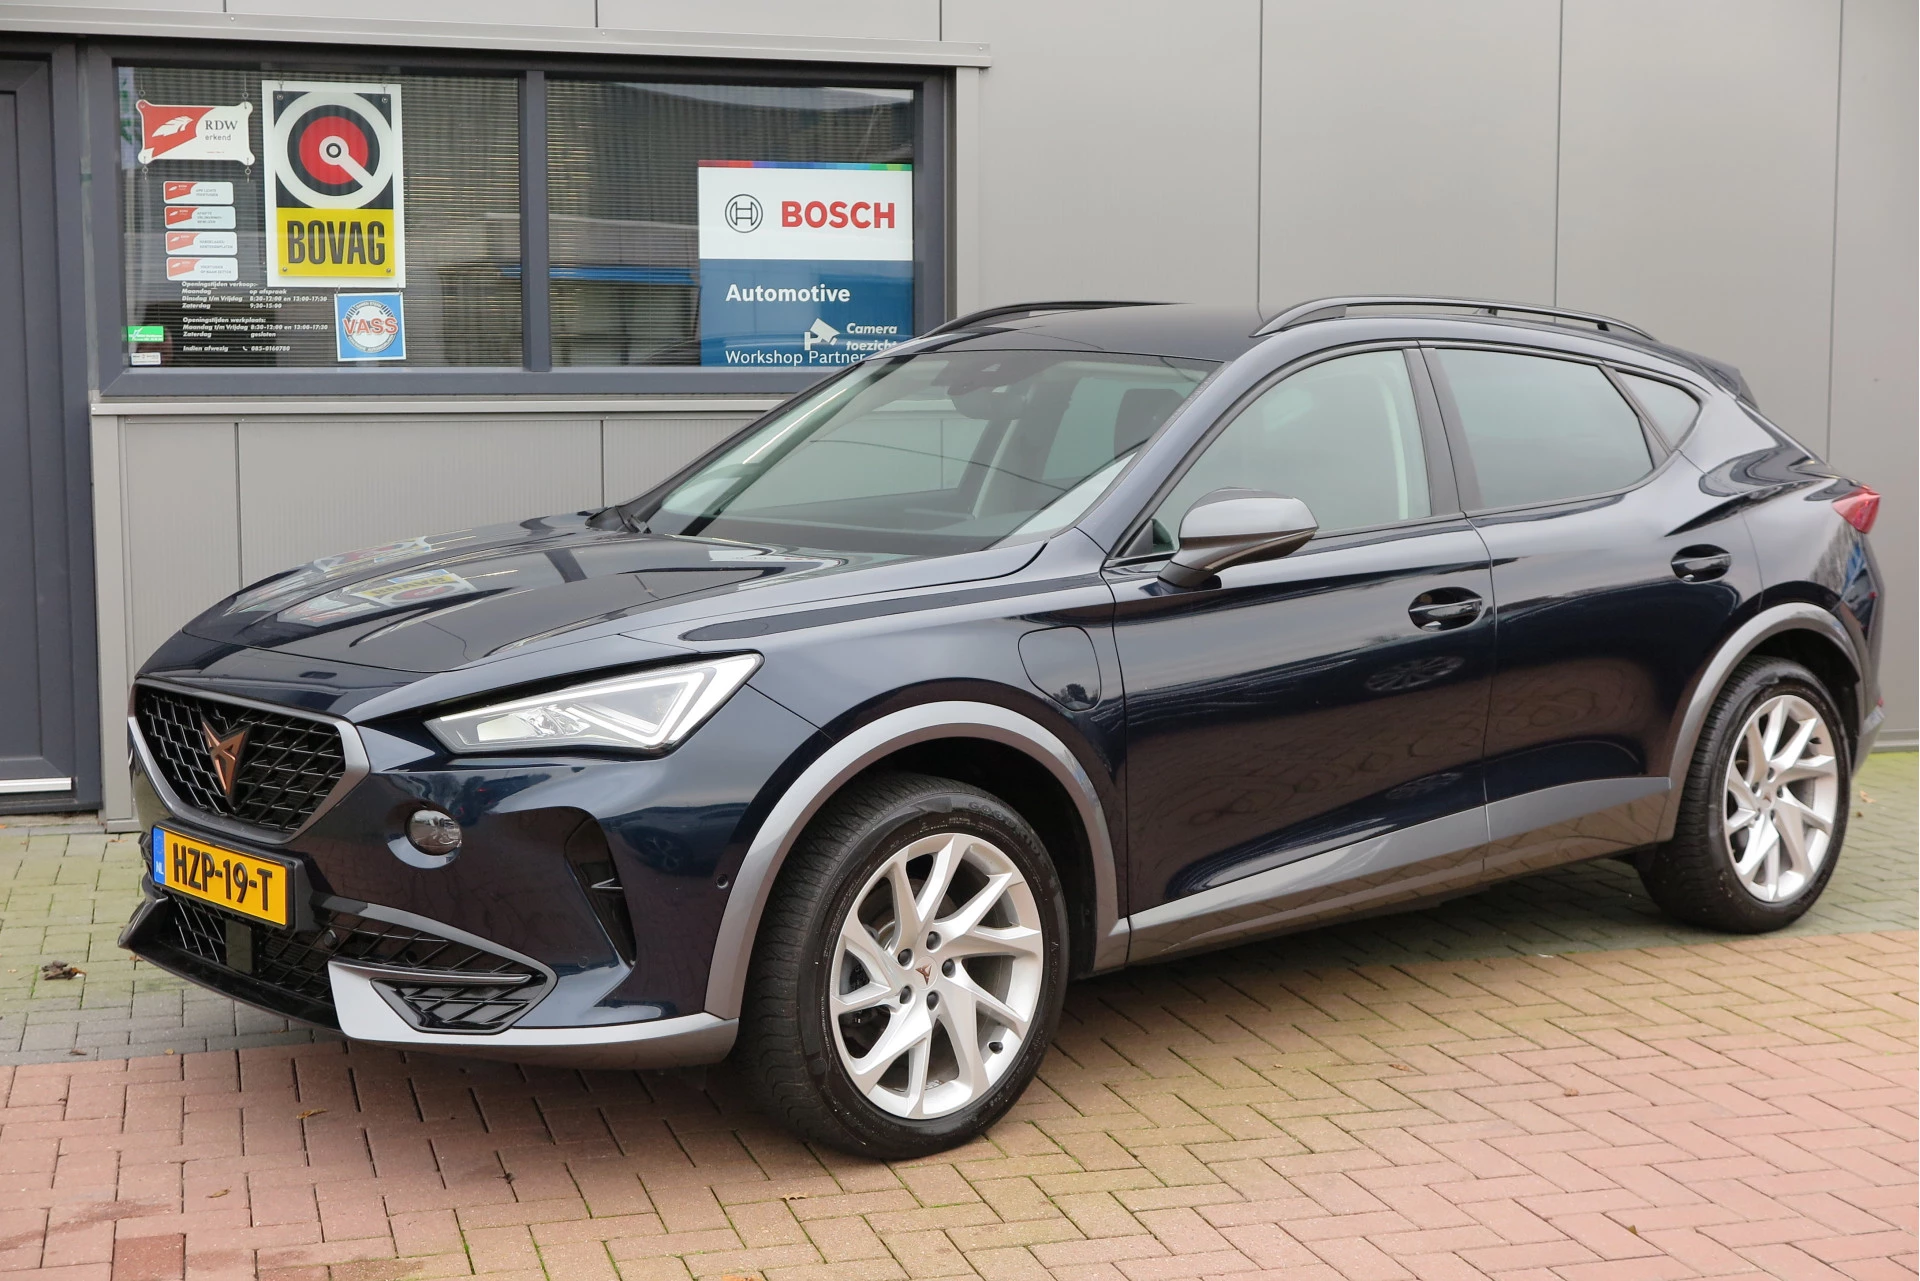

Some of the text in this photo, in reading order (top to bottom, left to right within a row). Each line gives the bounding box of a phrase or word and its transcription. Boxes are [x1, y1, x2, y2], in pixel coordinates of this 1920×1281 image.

[205, 120, 238, 130] RDW
[781, 201, 895, 228] BOSCH
[287, 220, 386, 265] BOVAG
[725, 284, 850, 302] Automotive
[343, 317, 398, 335] VASS
[846, 323, 898, 334] Camera
[725, 350, 866, 366] Workshop Partner
[156, 861, 164, 875] NL
[173, 842, 272, 911] HZP-19-T
